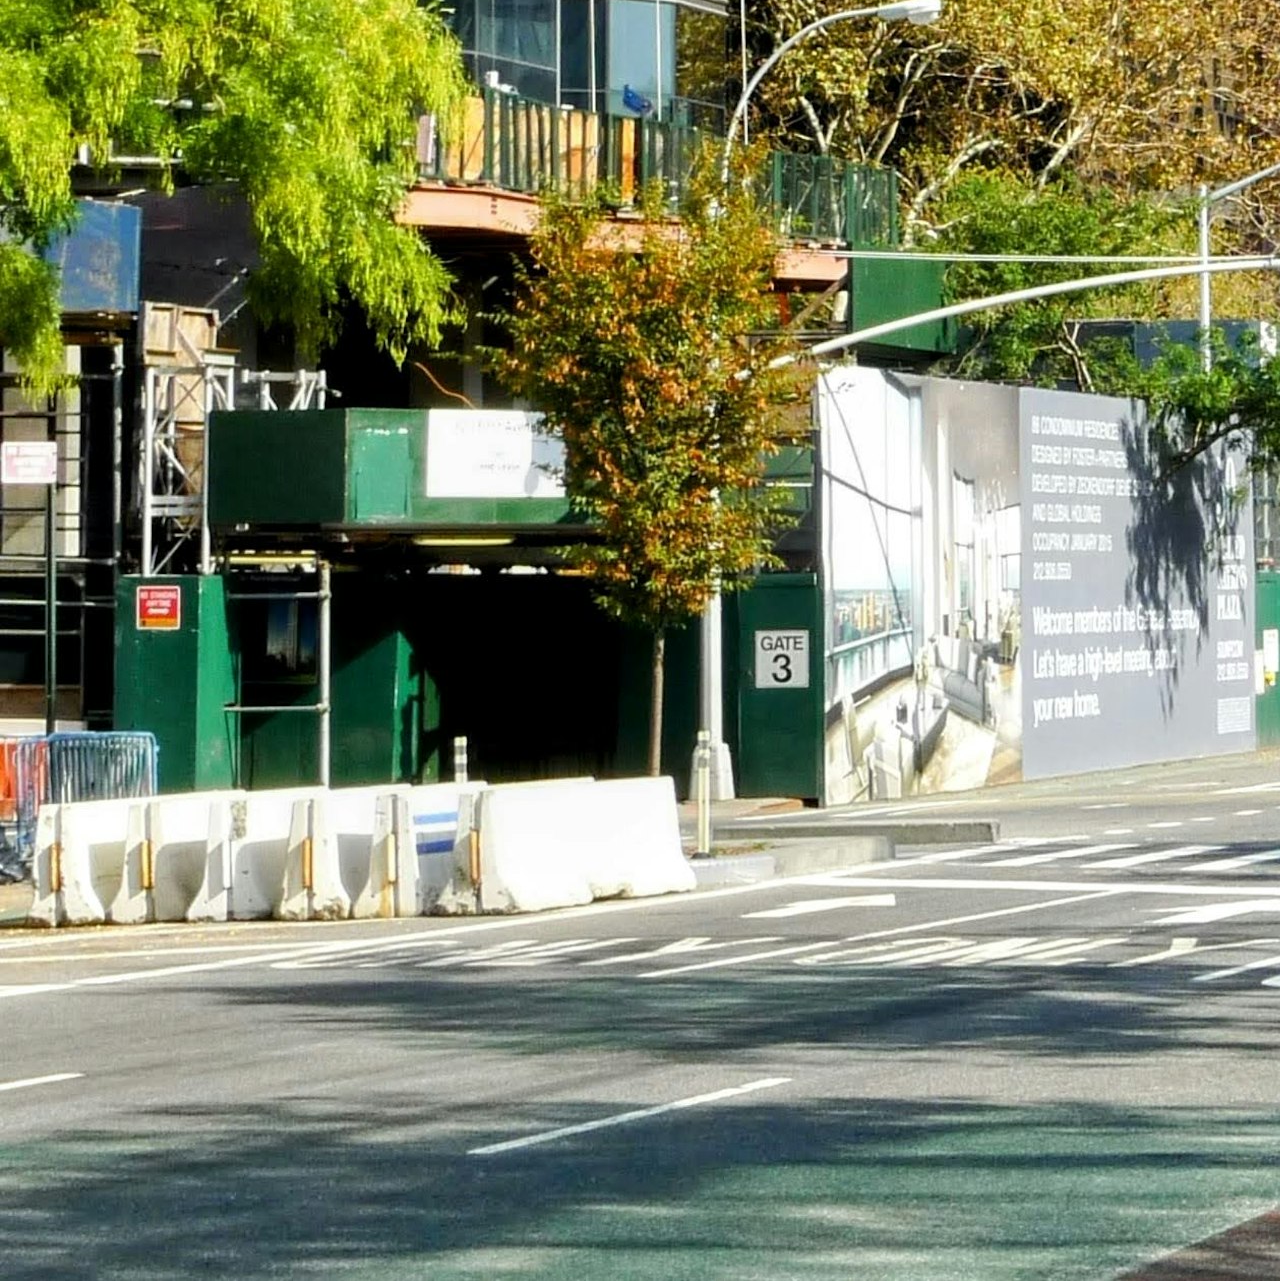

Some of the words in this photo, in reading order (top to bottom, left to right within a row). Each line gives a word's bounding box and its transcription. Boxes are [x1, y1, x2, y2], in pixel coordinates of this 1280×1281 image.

[1033, 606, 1073, 636] Welcome
[1074, 606, 1112, 634] members
[760, 635, 804, 651] GATE
[772, 653, 792, 684] 3
[1055, 647, 1077, 677] have
[1033, 697, 1053, 728] your
[1054, 696, 1073, 719] new
